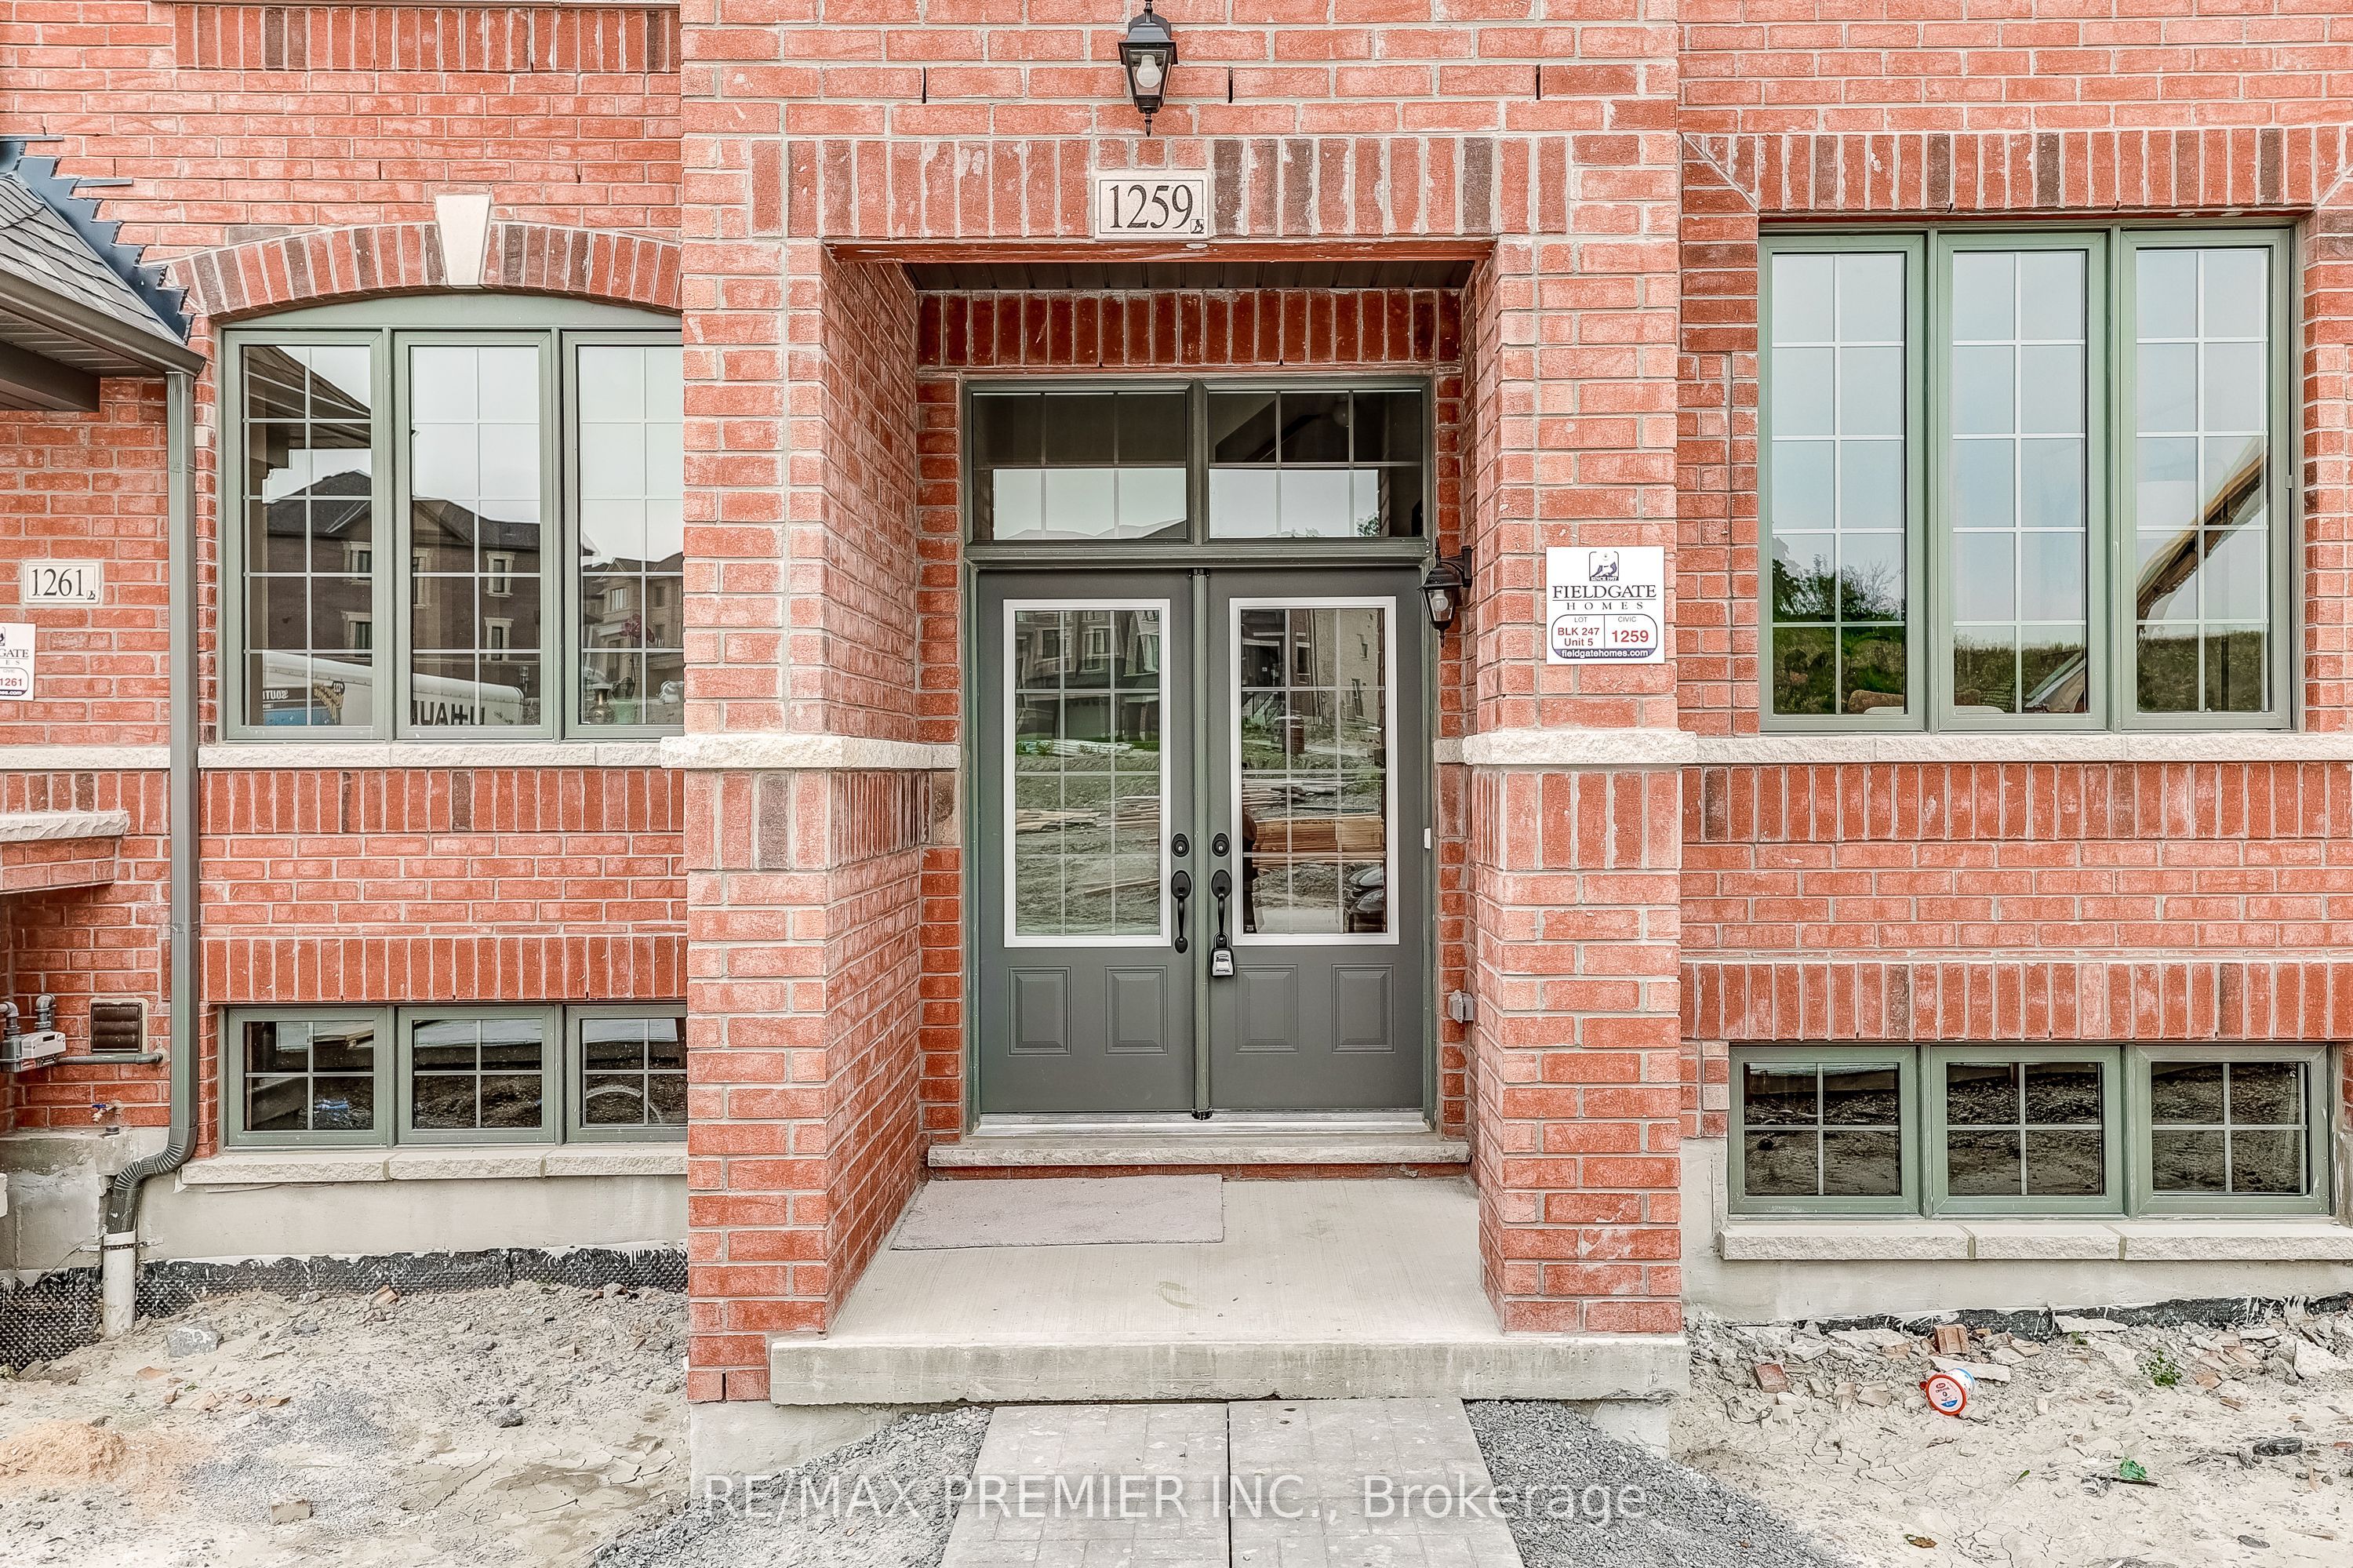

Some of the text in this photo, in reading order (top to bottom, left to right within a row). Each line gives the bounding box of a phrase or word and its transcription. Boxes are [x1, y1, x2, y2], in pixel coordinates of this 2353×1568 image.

[1110, 184, 1193, 229] 1259
[32, 568, 84, 597] 1261
[1552, 585, 1657, 598] FIELDGATE
[1566, 602, 1643, 610] HOMES
[1558, 627, 1600, 635] BLK 247
[1612, 630, 1649, 642] 1259
[1564, 638, 1594, 646] Unit 5
[1561, 649, 1649, 659] fieldgatehomes.com
[0, 678, 22, 686] 1261
